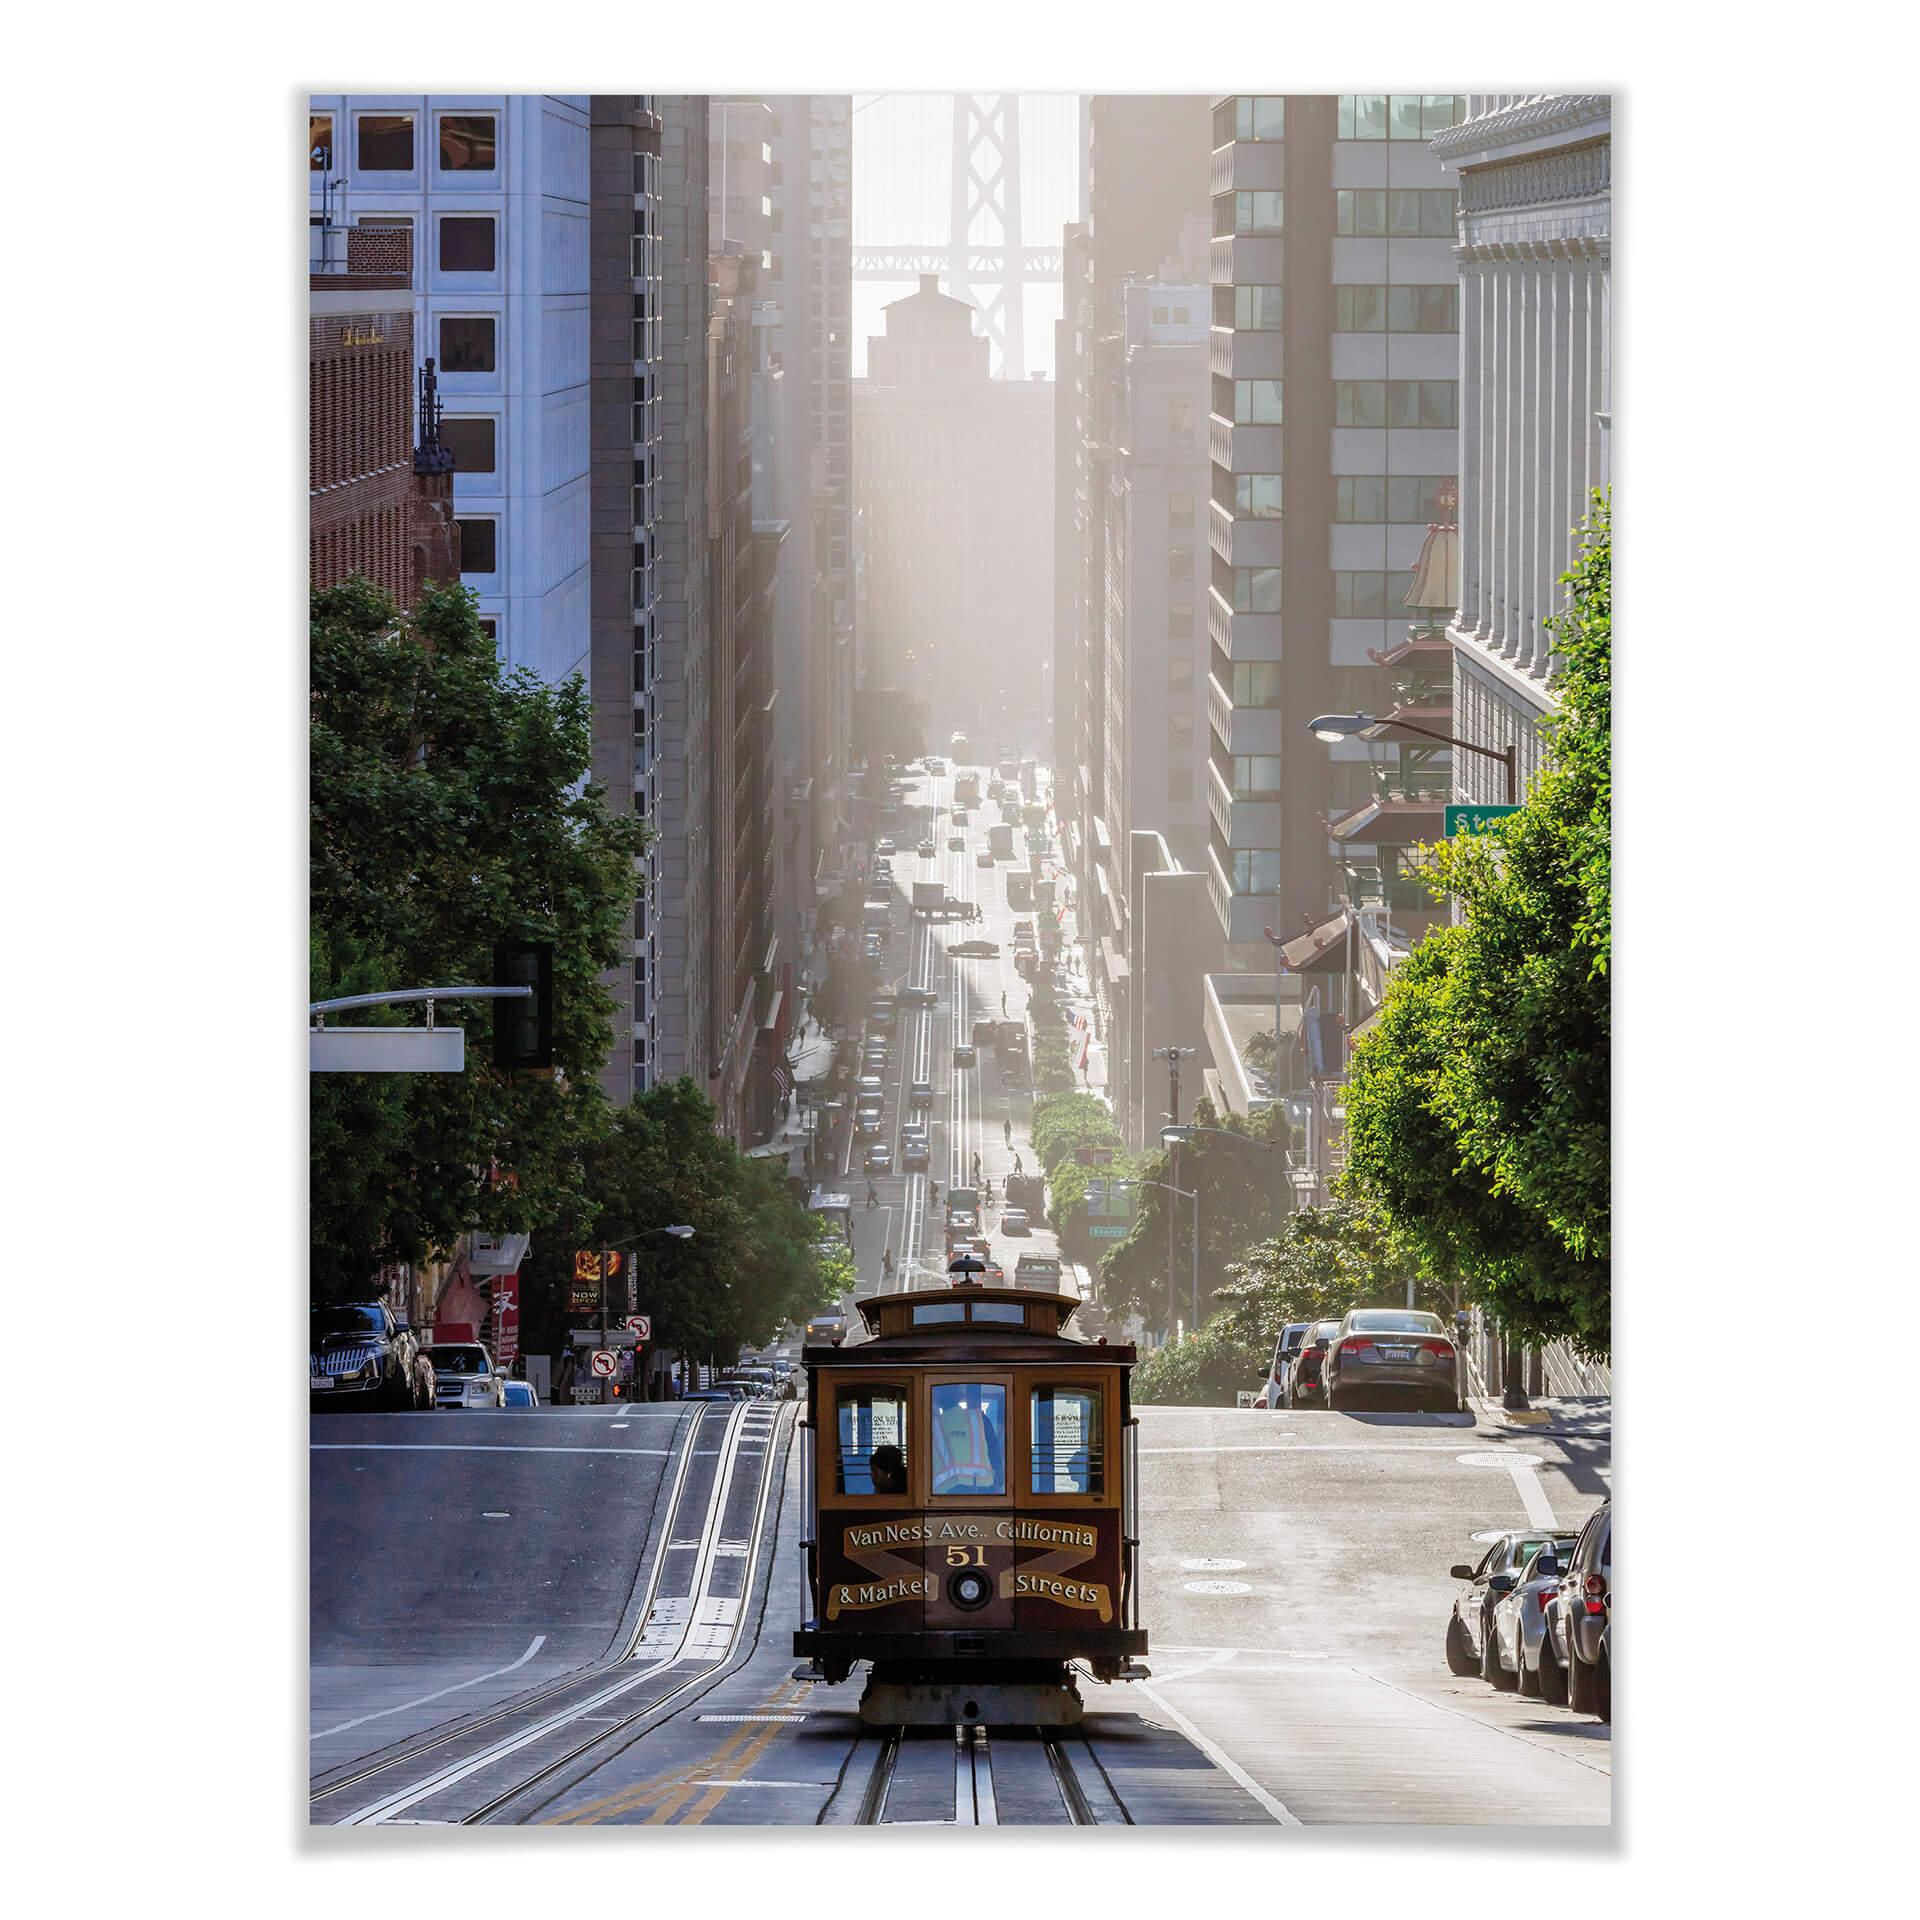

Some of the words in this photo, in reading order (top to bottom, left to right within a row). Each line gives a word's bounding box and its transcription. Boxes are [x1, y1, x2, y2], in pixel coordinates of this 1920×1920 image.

[849, 1529, 883, 1548] Van
[885, 1523, 933, 1544] Ness
[996, 1521, 1094, 1547] California
[945, 1545, 989, 1567] 51
[839, 1586, 854, 1604] &
[859, 1576, 930, 1603] Market
[1015, 1574, 1099, 1603] Streets
